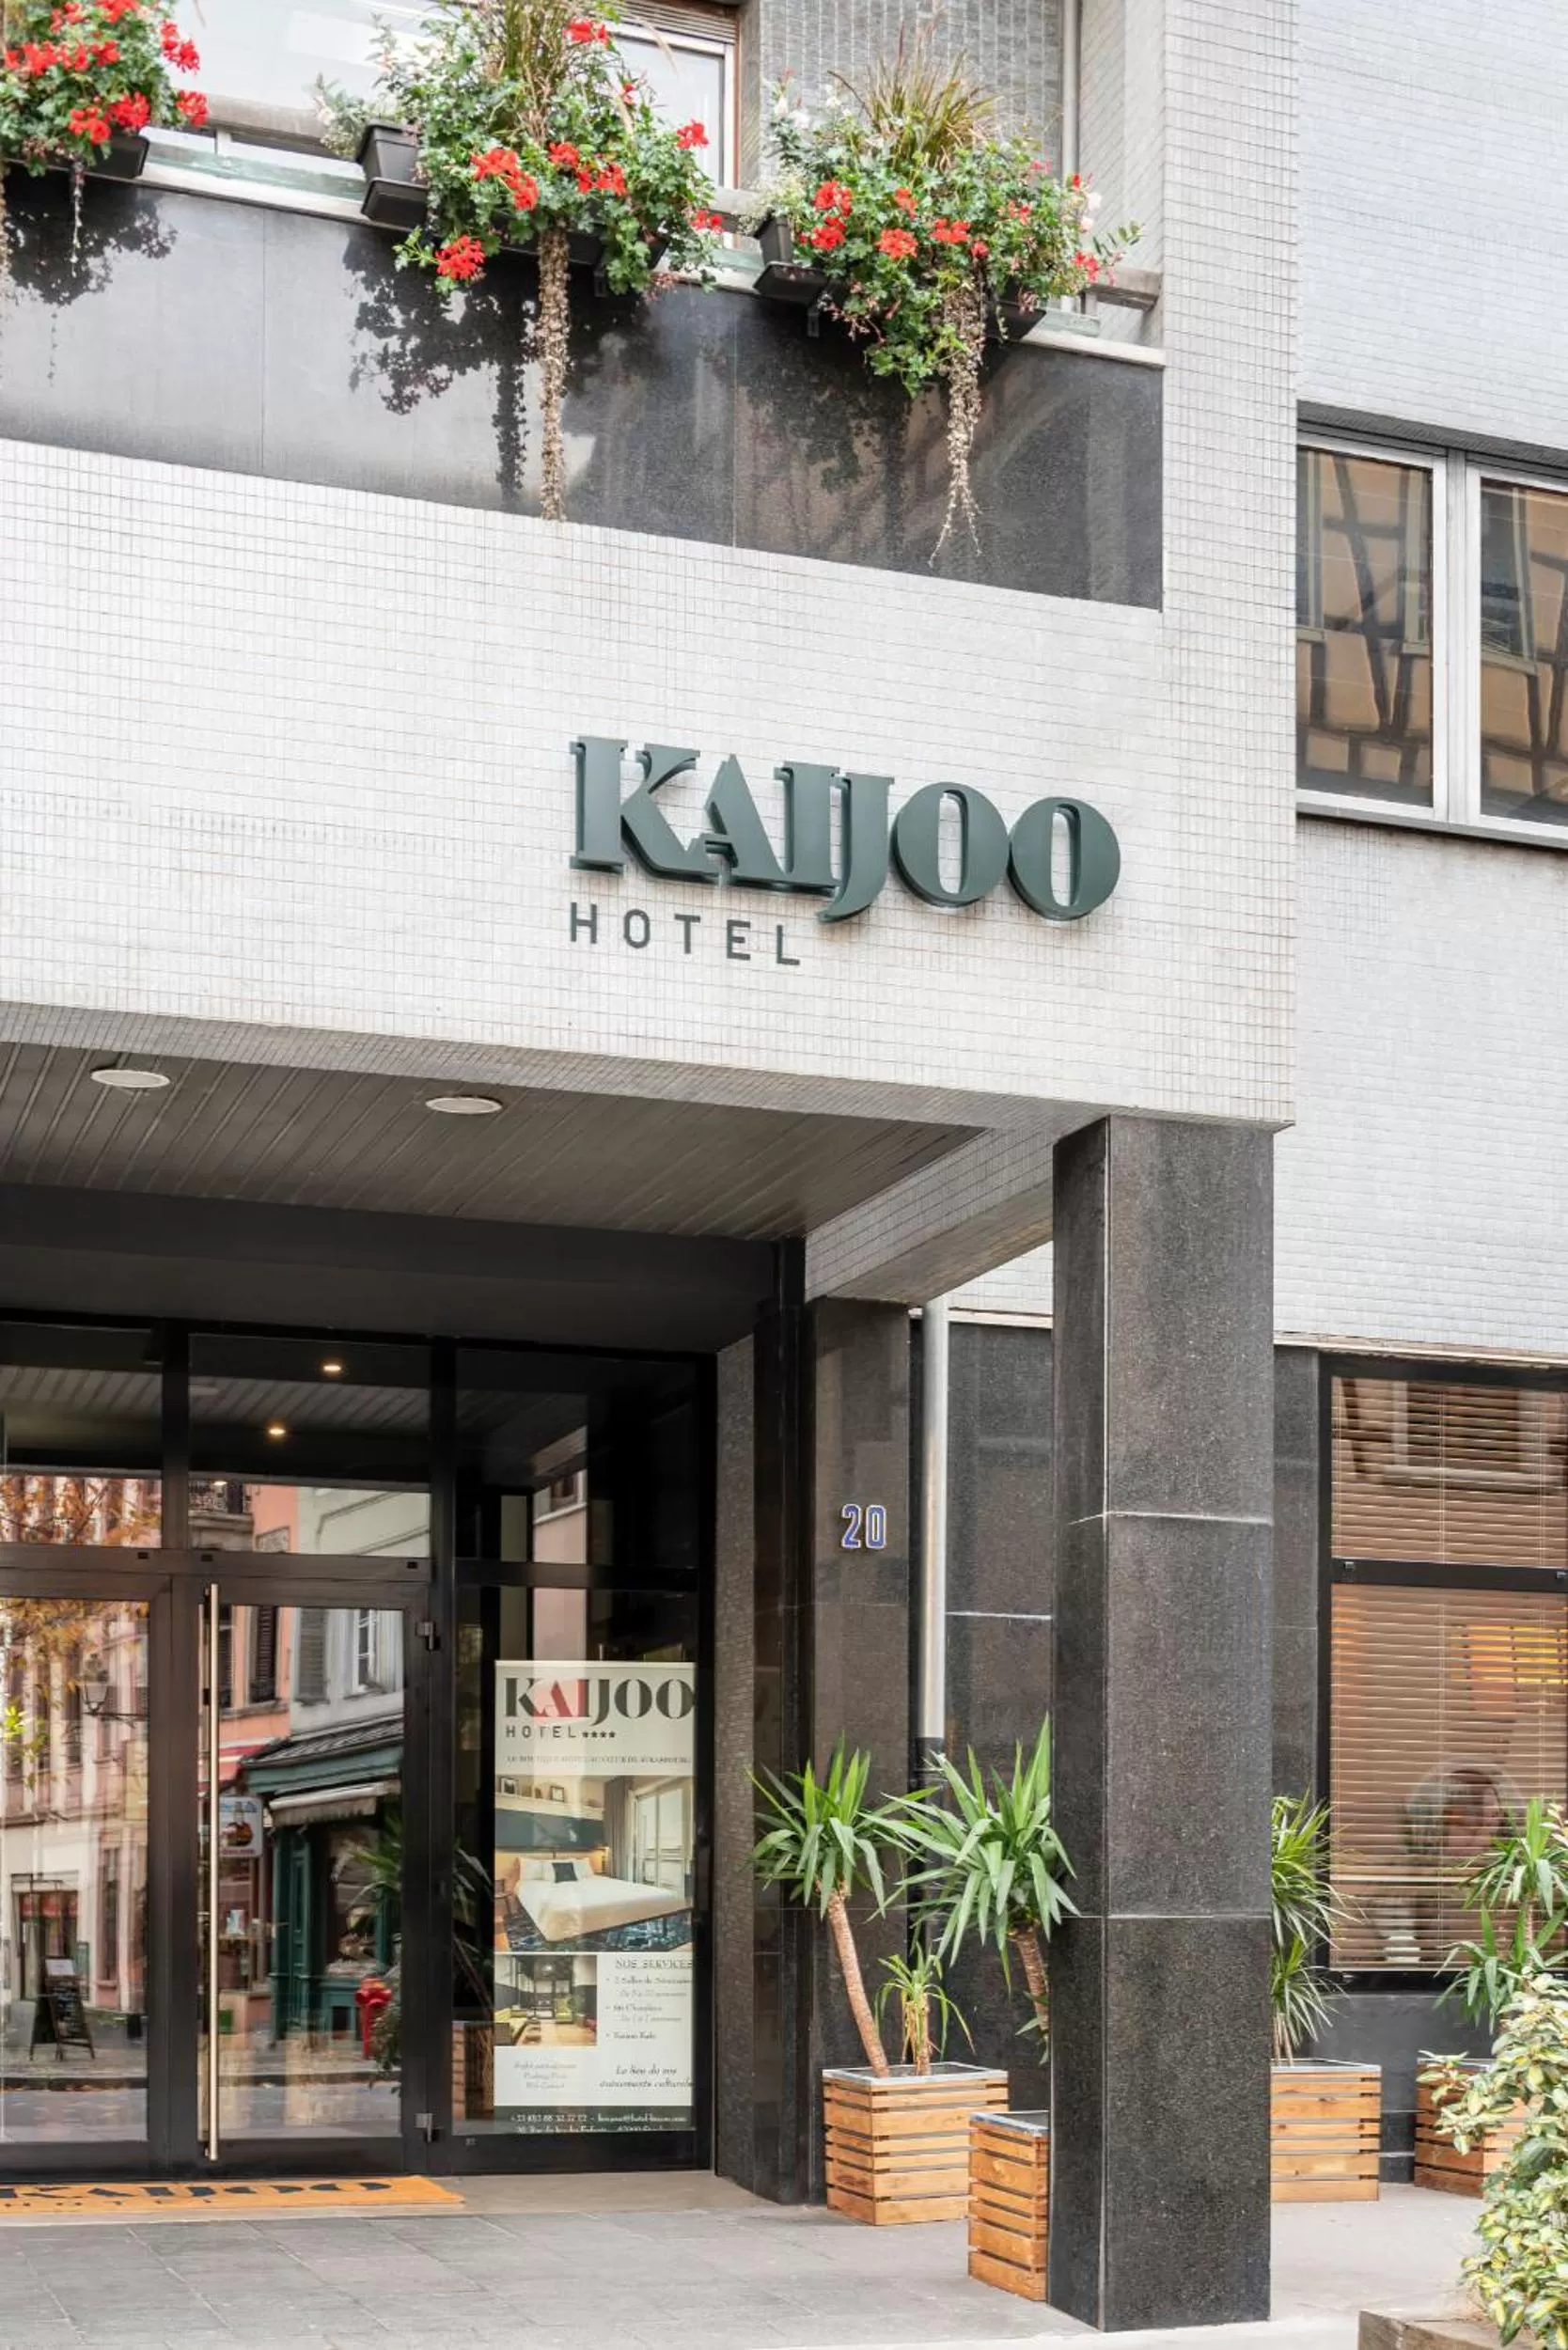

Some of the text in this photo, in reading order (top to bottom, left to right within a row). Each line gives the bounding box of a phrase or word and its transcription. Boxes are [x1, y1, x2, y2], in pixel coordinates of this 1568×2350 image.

[570, 735, 1121, 923] KAIJOO
[570, 901, 801, 966] HOTEL
[841, 1504, 886, 1549] 20
[505, 1677, 695, 1726] KAIJOO
[506, 1726, 576, 1738] HOTEL
